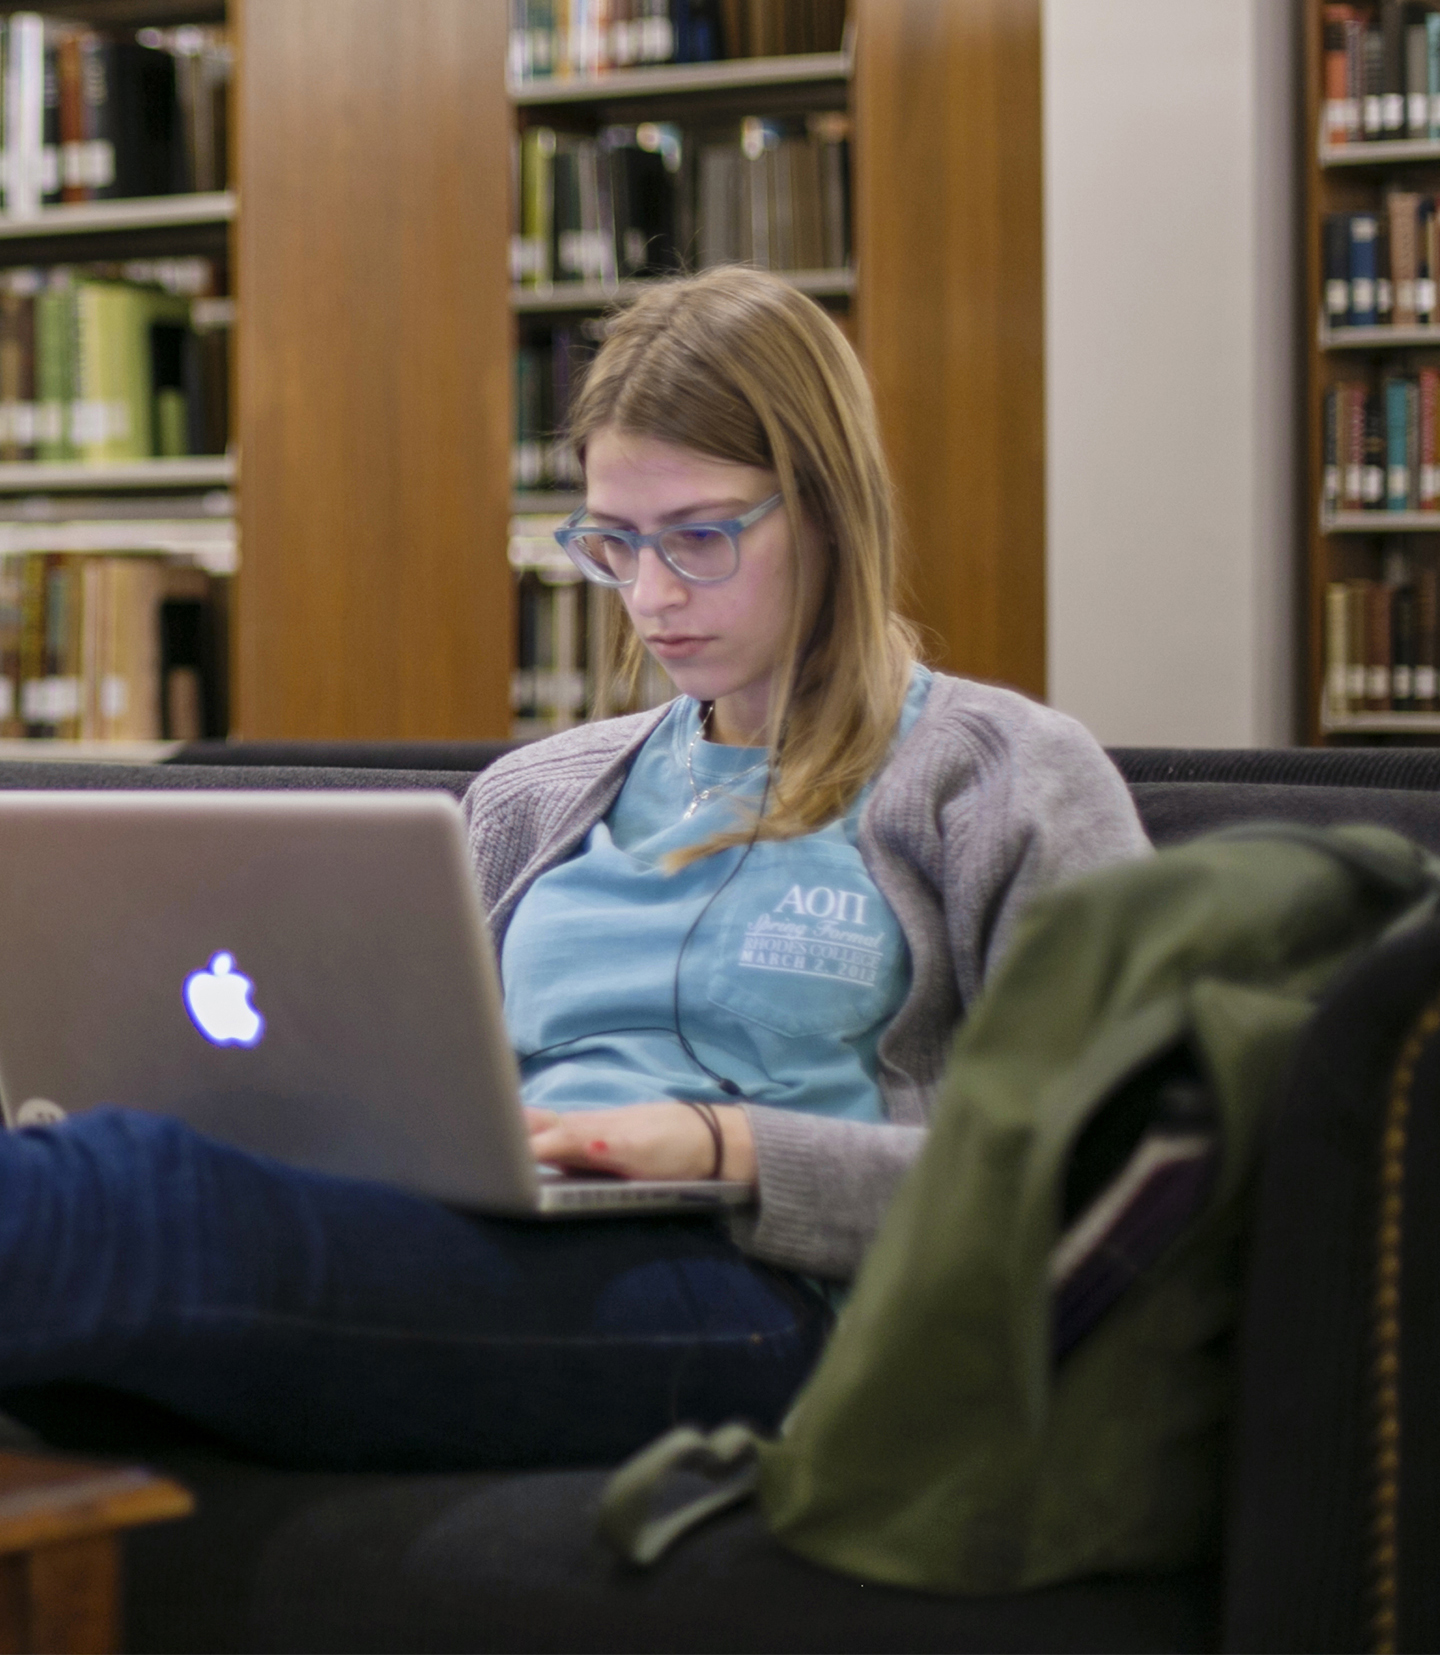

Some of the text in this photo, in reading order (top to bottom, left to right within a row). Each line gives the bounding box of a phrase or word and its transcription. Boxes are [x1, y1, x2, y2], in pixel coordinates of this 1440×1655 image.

[747, 913, 885, 948] Spring Formal
[741, 950, 806, 969] MARCH
[838, 962, 877, 982] 2013
[744, 937, 881, 969] RHODES COLLEGE
